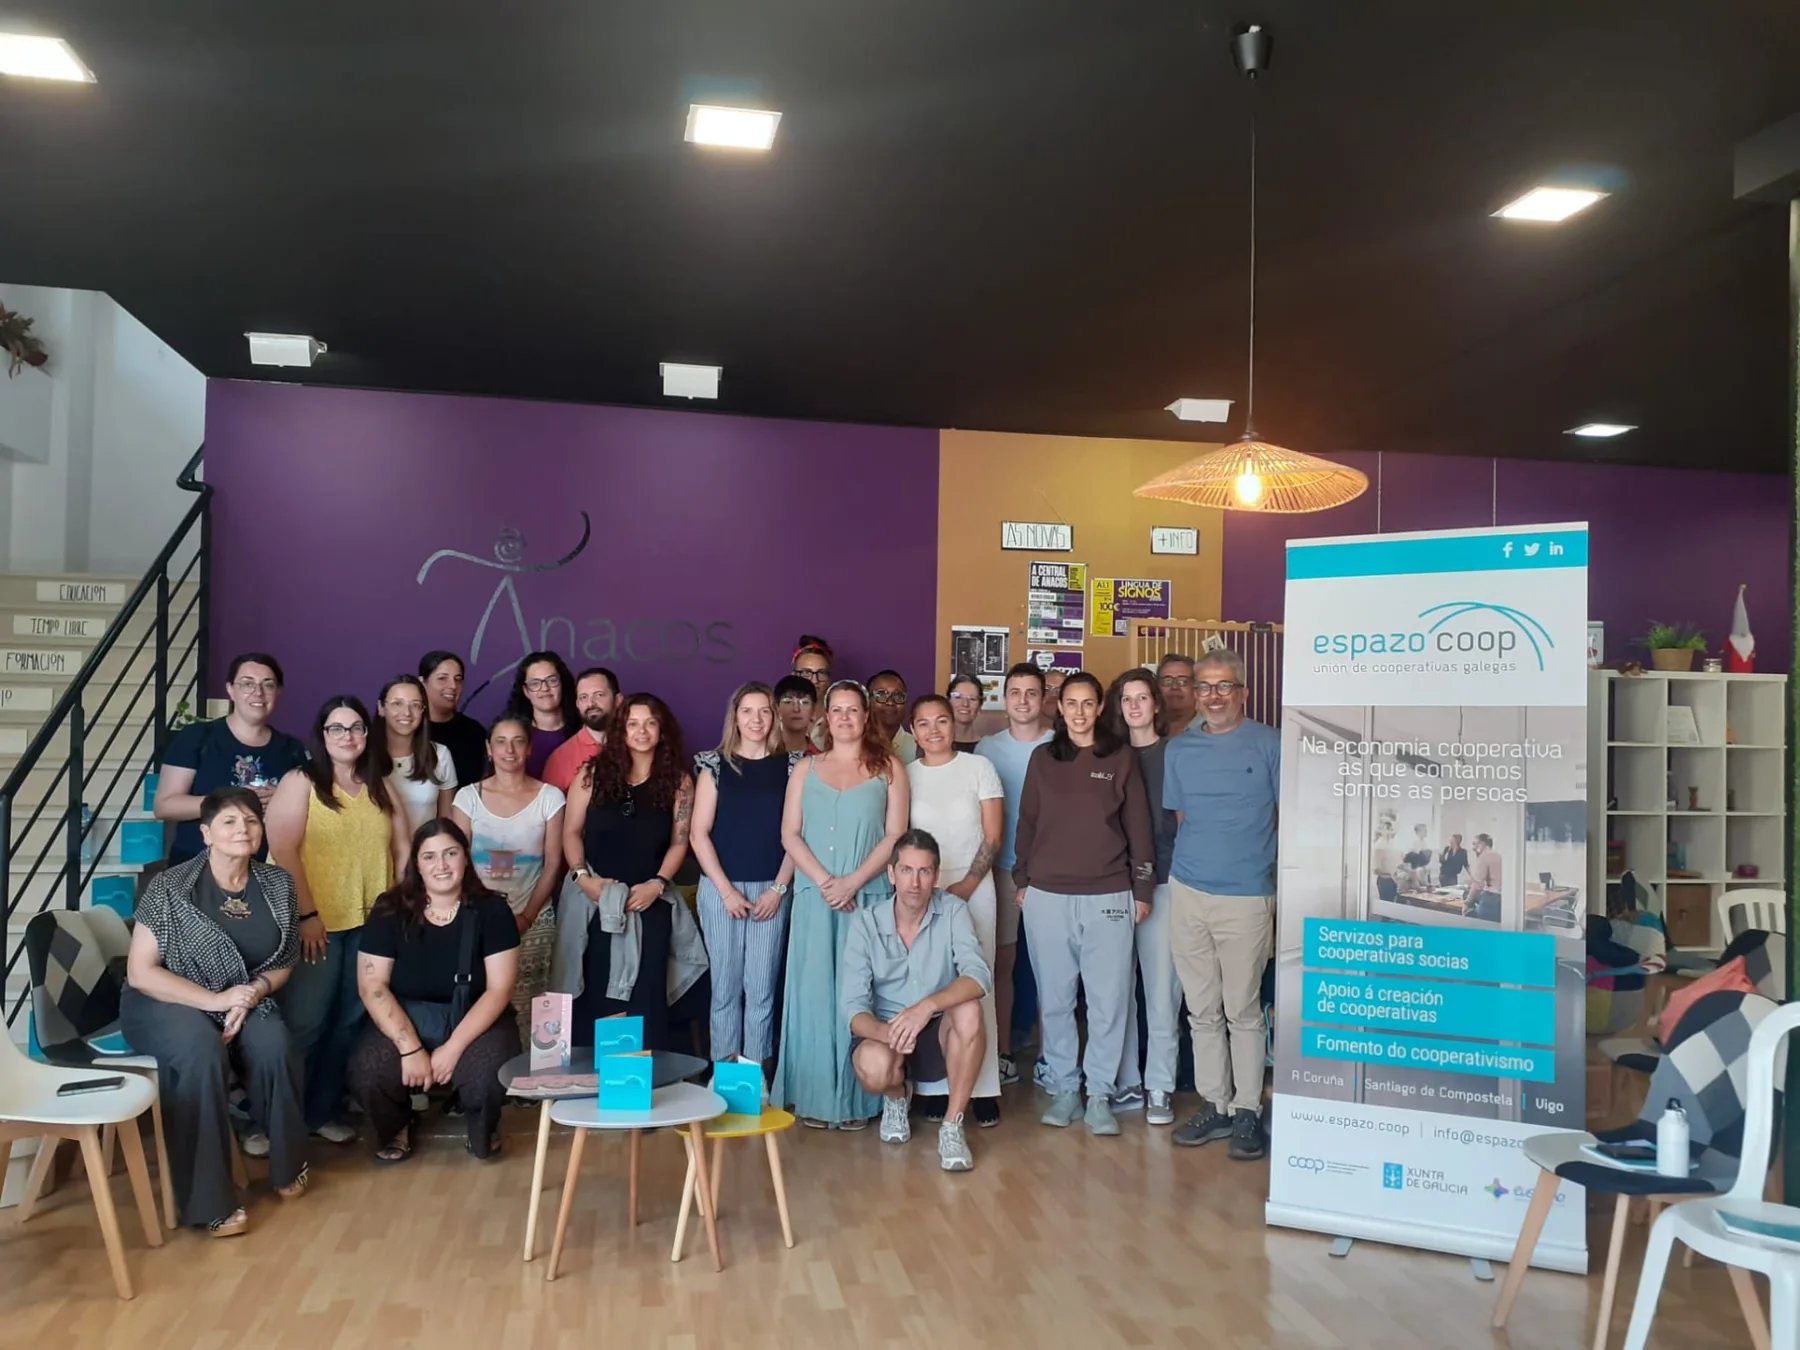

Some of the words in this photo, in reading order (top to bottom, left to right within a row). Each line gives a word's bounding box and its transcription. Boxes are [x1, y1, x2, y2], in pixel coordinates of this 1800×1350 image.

[1006, 523, 1023, 547] AS
[1031, 564, 1038, 576] A
[1038, 564, 1067, 577] CENTRAL
[1031, 575, 1041, 587] DE
[1041, 576, 1068, 588] ANACOS
[1118, 587, 1162, 598] SIGNOS
[1121, 580, 1150, 589] LINGUA
[30, 618, 60, 635] TEMPO
[64, 620, 88, 636] LIBRE
[470, 575, 737, 664] Anacos
[1313, 632, 1426, 661] espazo
[1436, 630, 1516, 659] coop
[1313, 661, 1348, 673] unión
[1352, 661, 1368, 673] de
[1372, 661, 1458, 675] cooperativas
[1463, 660, 1516, 675] galegas
[1302, 736, 1327, 755] Na
[1437, 738, 1563, 761] cooperativa
[1338, 762, 1362, 776] as
[1370, 762, 1407, 781] que
[1414, 760, 1523, 780] contamos
[1332, 783, 1401, 798] somos
[1408, 784, 1433, 799] as
[1440, 785, 1528, 805] persoas
[1318, 926, 1384, 946] Servizos
[1388, 934, 1424, 950] para
[1318, 946, 1415, 967] cooperativas
[1419, 952, 1469, 970] socias
[1317, 980, 1360, 999] Apoio
[1364, 985, 1374, 1000] á
[1378, 988, 1444, 1006] creación
[1317, 999, 1336, 1013] de
[1339, 1002, 1438, 1024] cooperativas
[1316, 1034, 1383, 1056] Fomento
[1387, 1042, 1407, 1059] do
[1411, 1047, 1535, 1073] cooperativismo
[1303, 1071, 1345, 1087] Coruña
[1364, 1078, 1417, 1096] Santiago
[1420, 1083, 1436, 1097] de
[1439, 1086, 1514, 1107] Compostela
[1535, 1097, 1565, 1113] Vigo
[1291, 1111, 1410, 1134] www.espazo.coop
[1288, 1155, 1326, 1175] coop
[1406, 1167, 1445, 1181] XUNTA
[1406, 1178, 1420, 1189] DE
[1422, 1180, 1468, 1196] GALICIA
